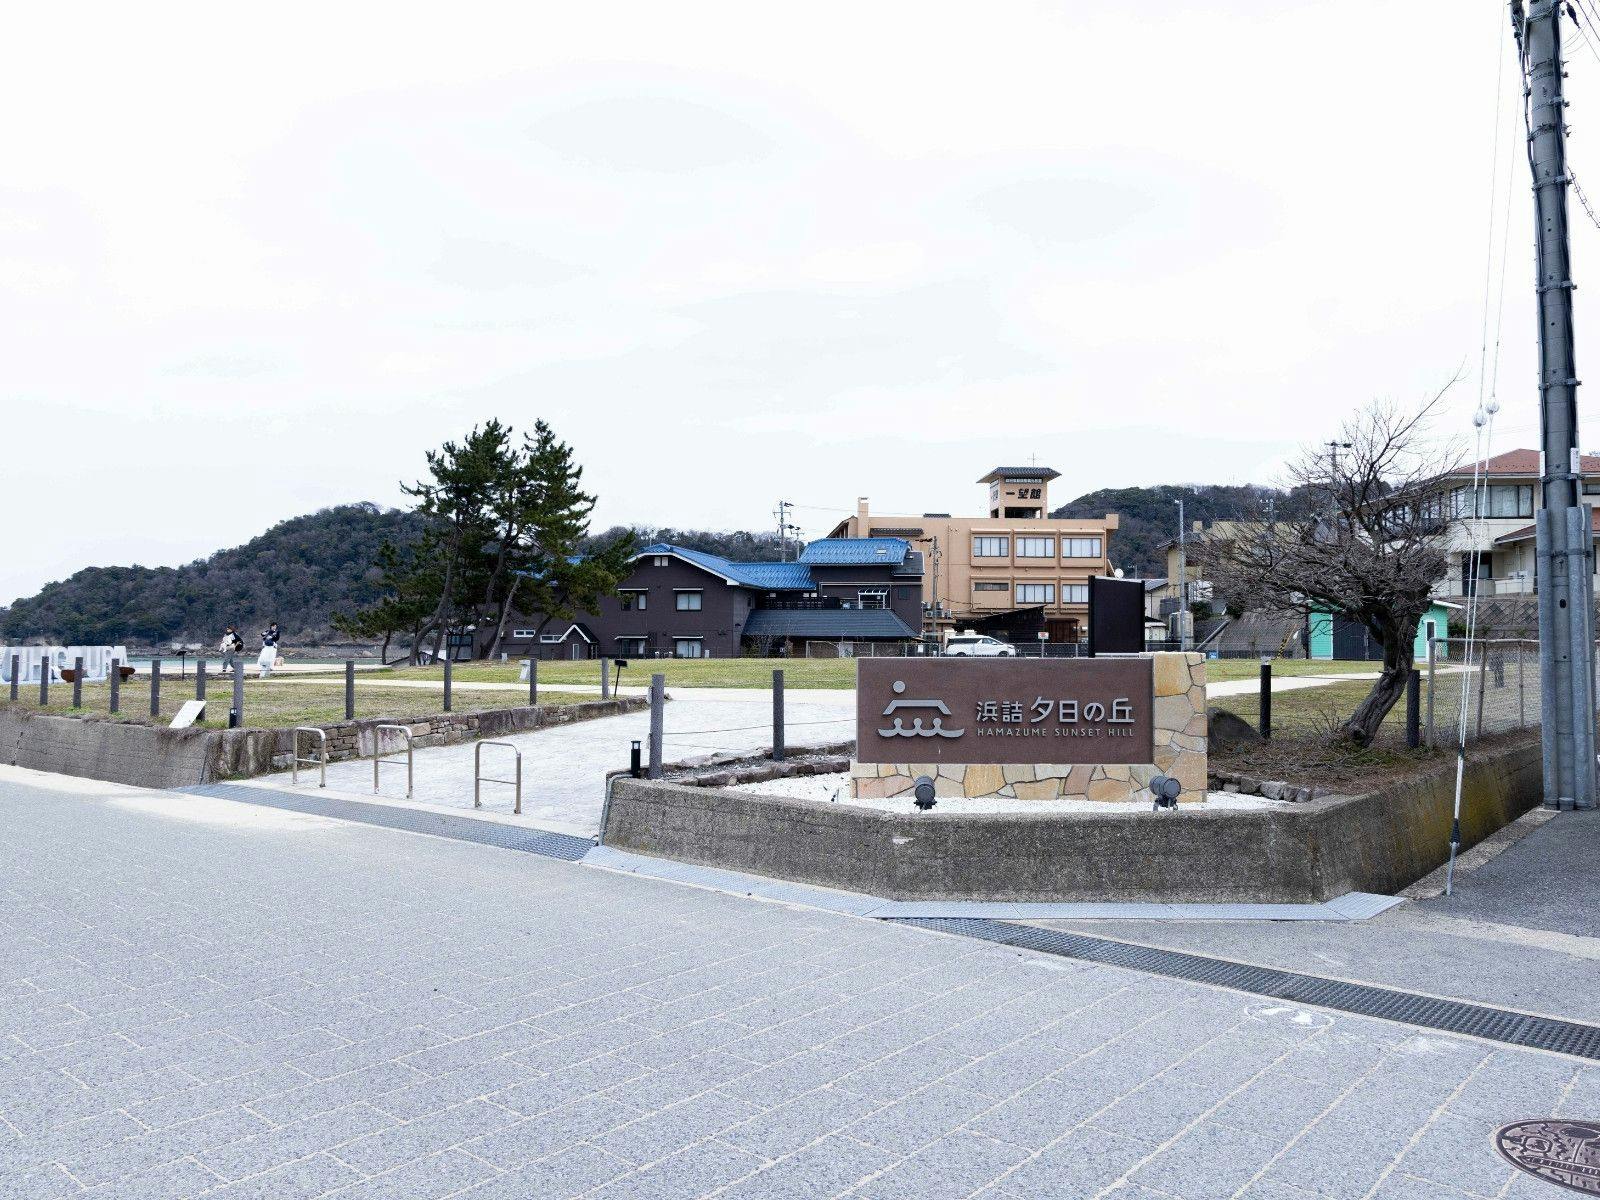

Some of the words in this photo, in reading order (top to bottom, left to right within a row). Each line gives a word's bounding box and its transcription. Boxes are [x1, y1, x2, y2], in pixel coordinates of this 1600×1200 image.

[1005, 488, 1042, 500] 一望館
[977, 728, 1047, 737] HAMAZUME
[1054, 728, 1101, 737] SUNSET
[1108, 728, 1134, 737] HILL
